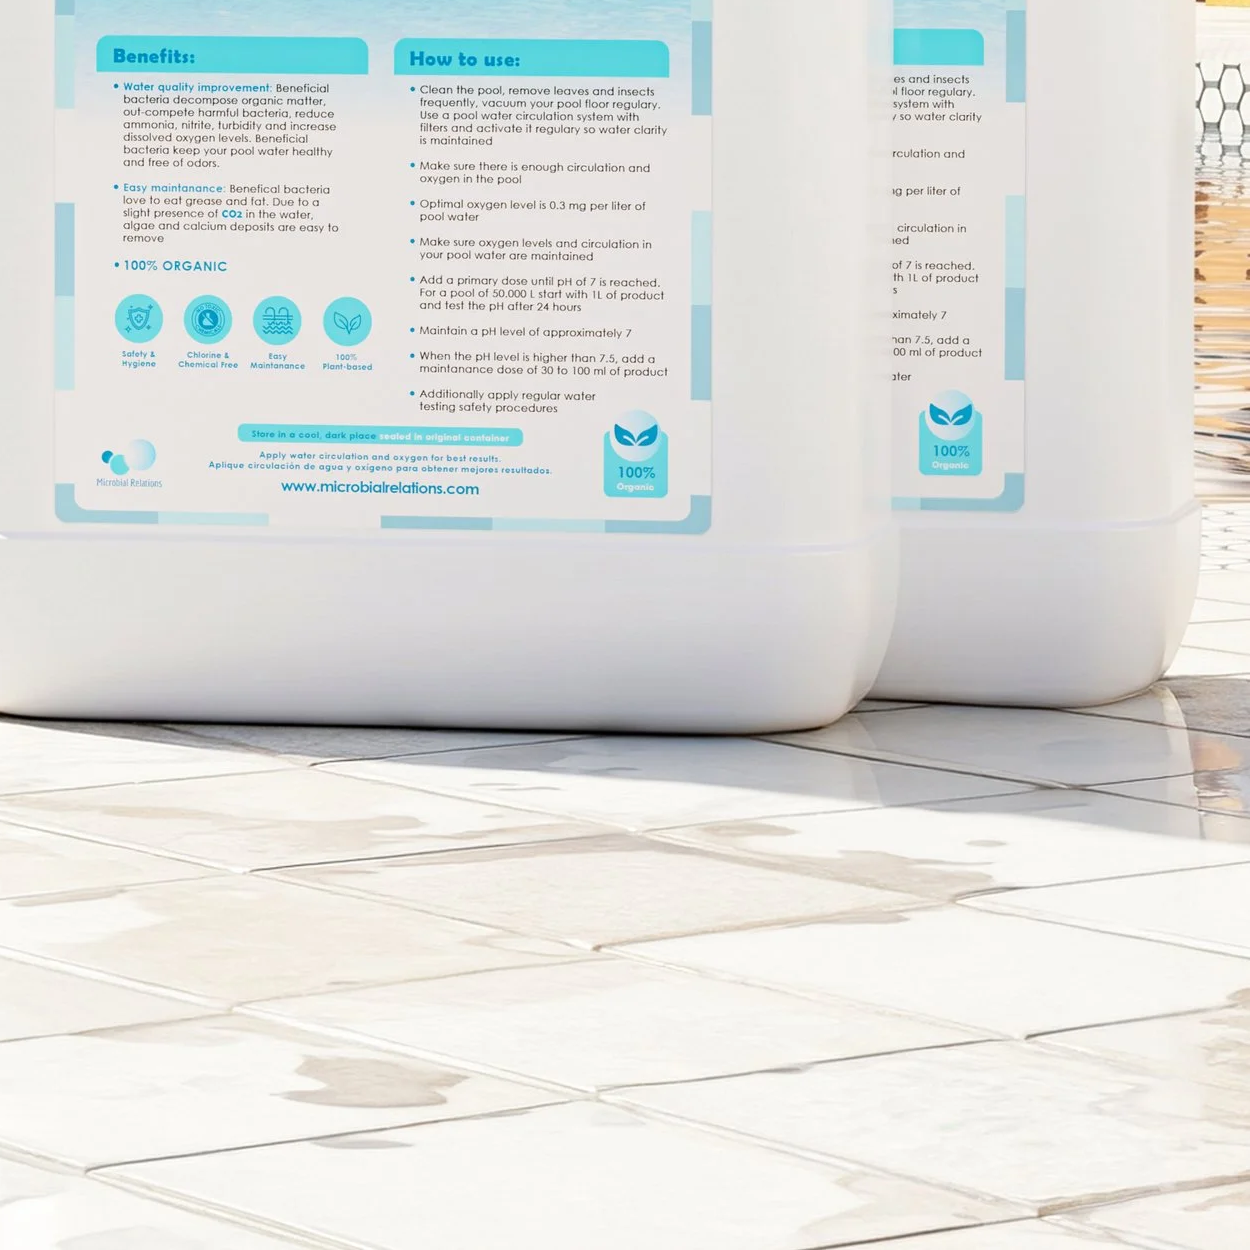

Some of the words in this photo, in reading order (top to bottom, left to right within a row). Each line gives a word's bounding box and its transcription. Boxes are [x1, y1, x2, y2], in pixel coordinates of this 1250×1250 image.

[113, 47, 195, 64] Benefits:
[409, 50, 452, 66] How
[457, 51, 477, 66] to
[483, 55, 520, 67] use:
[123, 81, 154, 91] Water
[157, 81, 194, 93] quality
[197, 82, 272, 94] improvement:
[276, 83, 329, 93] Beneficial
[123, 94, 170, 104] bacteria
[172, 94, 238, 106] decompose
[241, 95, 283, 107] organic
[286, 95, 326, 106] matter,
[892, 99, 929, 110] system
[122, 106, 195, 118] out-compete
[197, 107, 239, 117] harmful
[242, 108, 291, 119] bacteria,
[294, 108, 335, 118] reduce
[948, 111, 982, 123] clarity
[122, 119, 177, 130] ammonia,
[181, 119, 214, 130] nitrite,
[217, 120, 262, 131] turbidity
[264, 120, 287, 131] and
[290, 120, 337, 131] increase
[122, 131, 172, 142] dissolved
[175, 134, 216, 144] oxygen
[254, 133, 308, 143] Beneficial
[123, 144, 170, 154] bacteria
[172, 145, 201, 156] keep
[203, 147, 227, 157] your
[230, 146, 255, 157] pool
[257, 146, 289, 156] water
[291, 146, 333, 158] healthy
[892, 148, 941, 158] rculation
[122, 157, 145, 167] and
[147, 157, 170, 167] free
[172, 157, 184, 167] of
[419, 160, 451, 170] Make
[453, 163, 476, 172] sure
[478, 161, 508, 171] there
[510, 161, 518, 171] is
[520, 161, 564, 173] enough
[566, 162, 625, 172] circulation
[628, 163, 650, 173] and
[419, 198, 464, 210] Optimal
[466, 201, 507, 211] oxygen
[510, 199, 536, 209] level
[538, 200, 547, 210] is
[548, 200, 566, 210] 0.3
[568, 202, 587, 212] mg
[589, 202, 608, 212] per
[611, 200, 632, 211] liter
[634, 201, 646, 211] of
[419, 211, 445, 222] pool
[447, 211, 479, 221] water
[124, 259, 158, 271] 100%
[162, 260, 227, 272] ORGANIC
[935, 272, 979, 284] product
[121, 349, 148, 359] Safety
[186, 351, 222, 360] Chlorine
[268, 352, 287, 362] Easy
[336, 353, 357, 362] 100%
[938, 348, 982, 359] product
[121, 359, 156, 369] Hygiene
[177, 360, 218, 369] Chemical
[220, 361, 239, 369] Free
[249, 361, 305, 371] Maintanance
[322, 362, 373, 371] Plant-based
[251, 429, 275, 439] Store
[277, 430, 286, 439] in
[324, 430, 346, 440] dark
[348, 431, 377, 441] place
[378, 432, 412, 441] sealed
[413, 432, 423, 441] in
[424, 433, 461, 443] original
[463, 434, 509, 443] container
[933, 444, 970, 457] 100%
[931, 460, 969, 470] Organic
[618, 465, 656, 479] 100%
[96, 477, 129, 487] Microbial
[129, 477, 163, 488] Relations
[281, 479, 479, 495] www.microbialrelations.com
[616, 482, 654, 492] Organic
